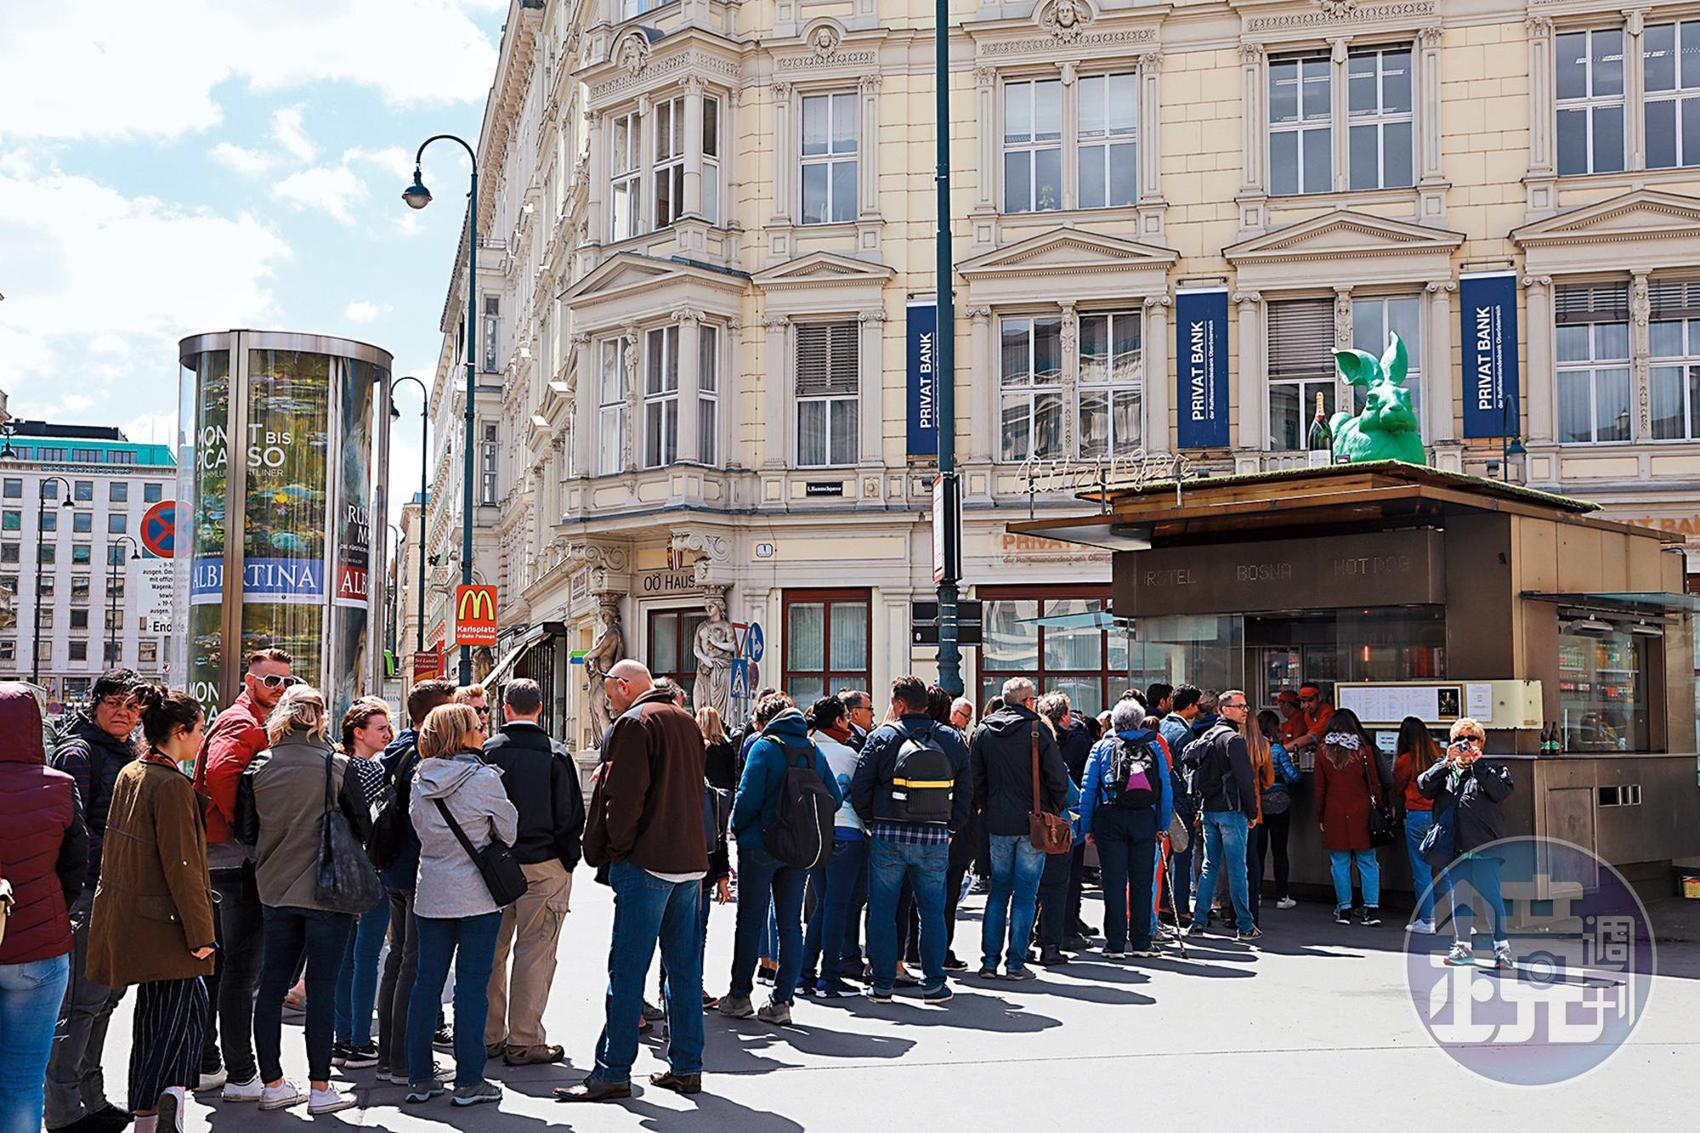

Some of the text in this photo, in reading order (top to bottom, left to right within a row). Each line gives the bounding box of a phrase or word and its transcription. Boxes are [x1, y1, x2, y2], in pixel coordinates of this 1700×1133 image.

[1476, 305, 1492, 410] PRIVAT BANK
[919, 332, 932, 429] PRIVAT BANK
[1190, 320, 1205, 421] PRIVAT BANK
[197, 423, 292, 447] MONT BIS
[197, 446, 286, 470] PICASO
[193, 563, 317, 589] ALBTINA
[1144, 569, 1197, 587] RSTEL
[1237, 563, 1292, 581] BOSNA
[1334, 557, 1369, 576] HOT
[643, 573, 695, 591] OÖ HAUS
[456, 625, 496, 634] Karlsplatz
